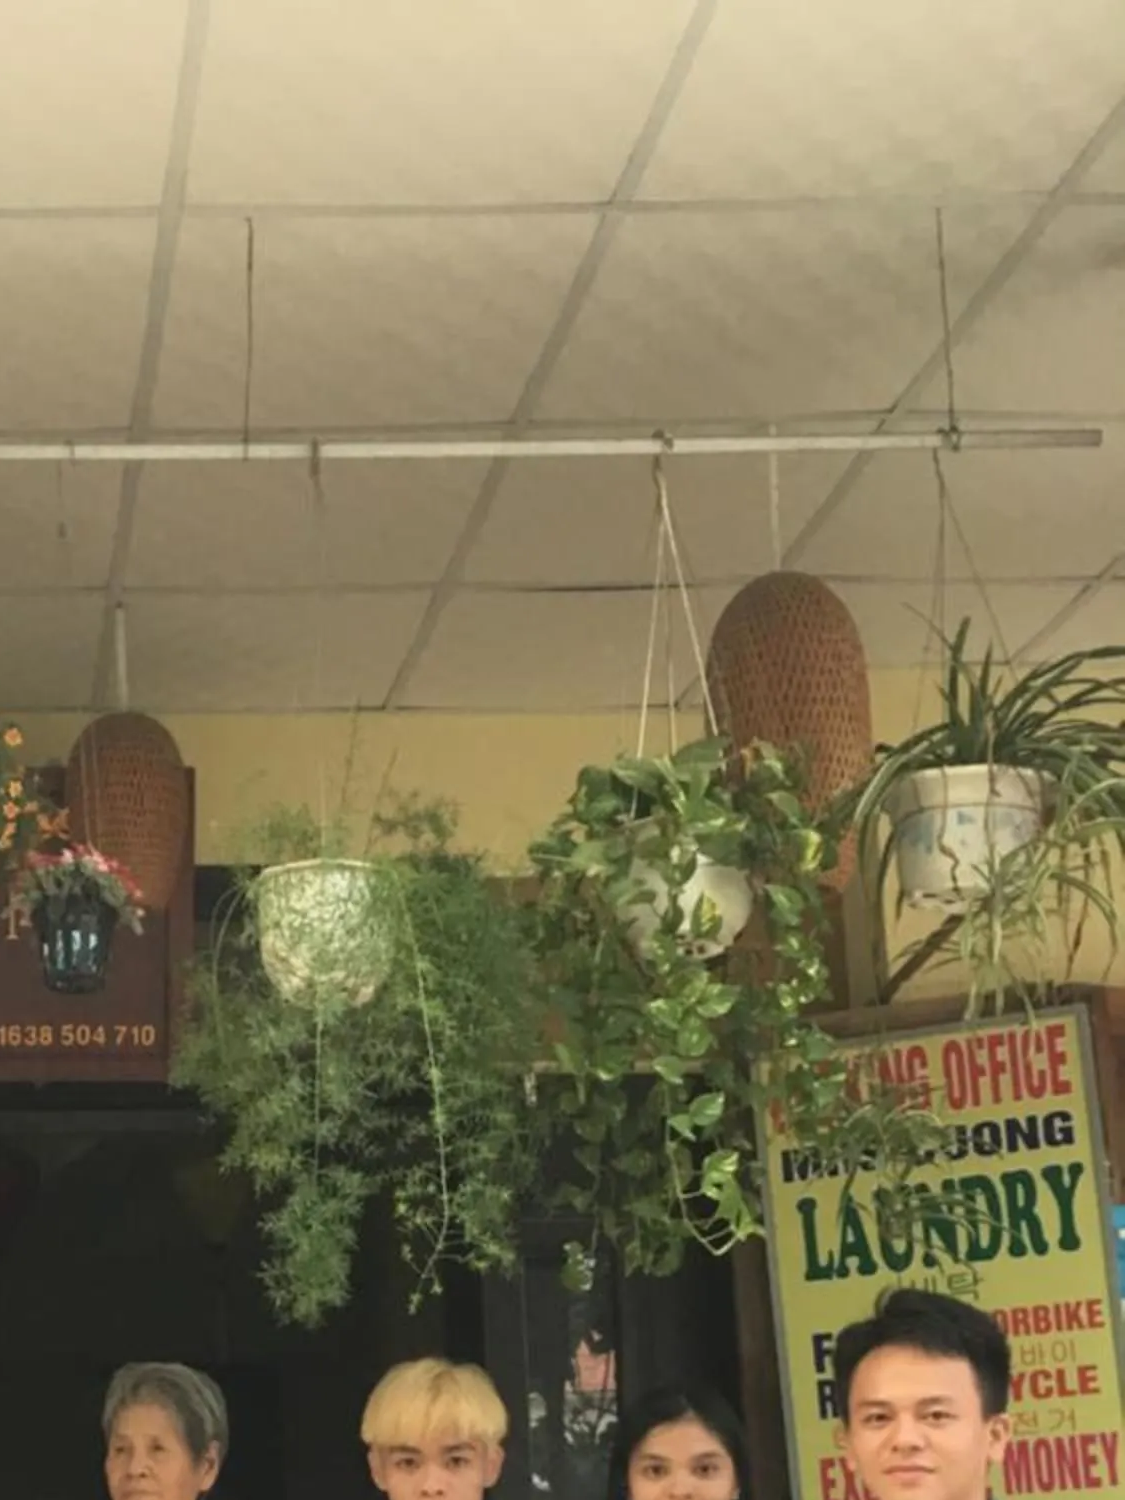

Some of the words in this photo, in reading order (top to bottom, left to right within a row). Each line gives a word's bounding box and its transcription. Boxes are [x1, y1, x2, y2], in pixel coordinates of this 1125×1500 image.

[60, 1024, 107, 1047] 504
[114, 1024, 156, 1047] 710
[942, 1023, 1073, 1112] OFFICE
[796, 1162, 1085, 1282] LAUNDRY
[1003, 1431, 1120, 1496] MONEY
